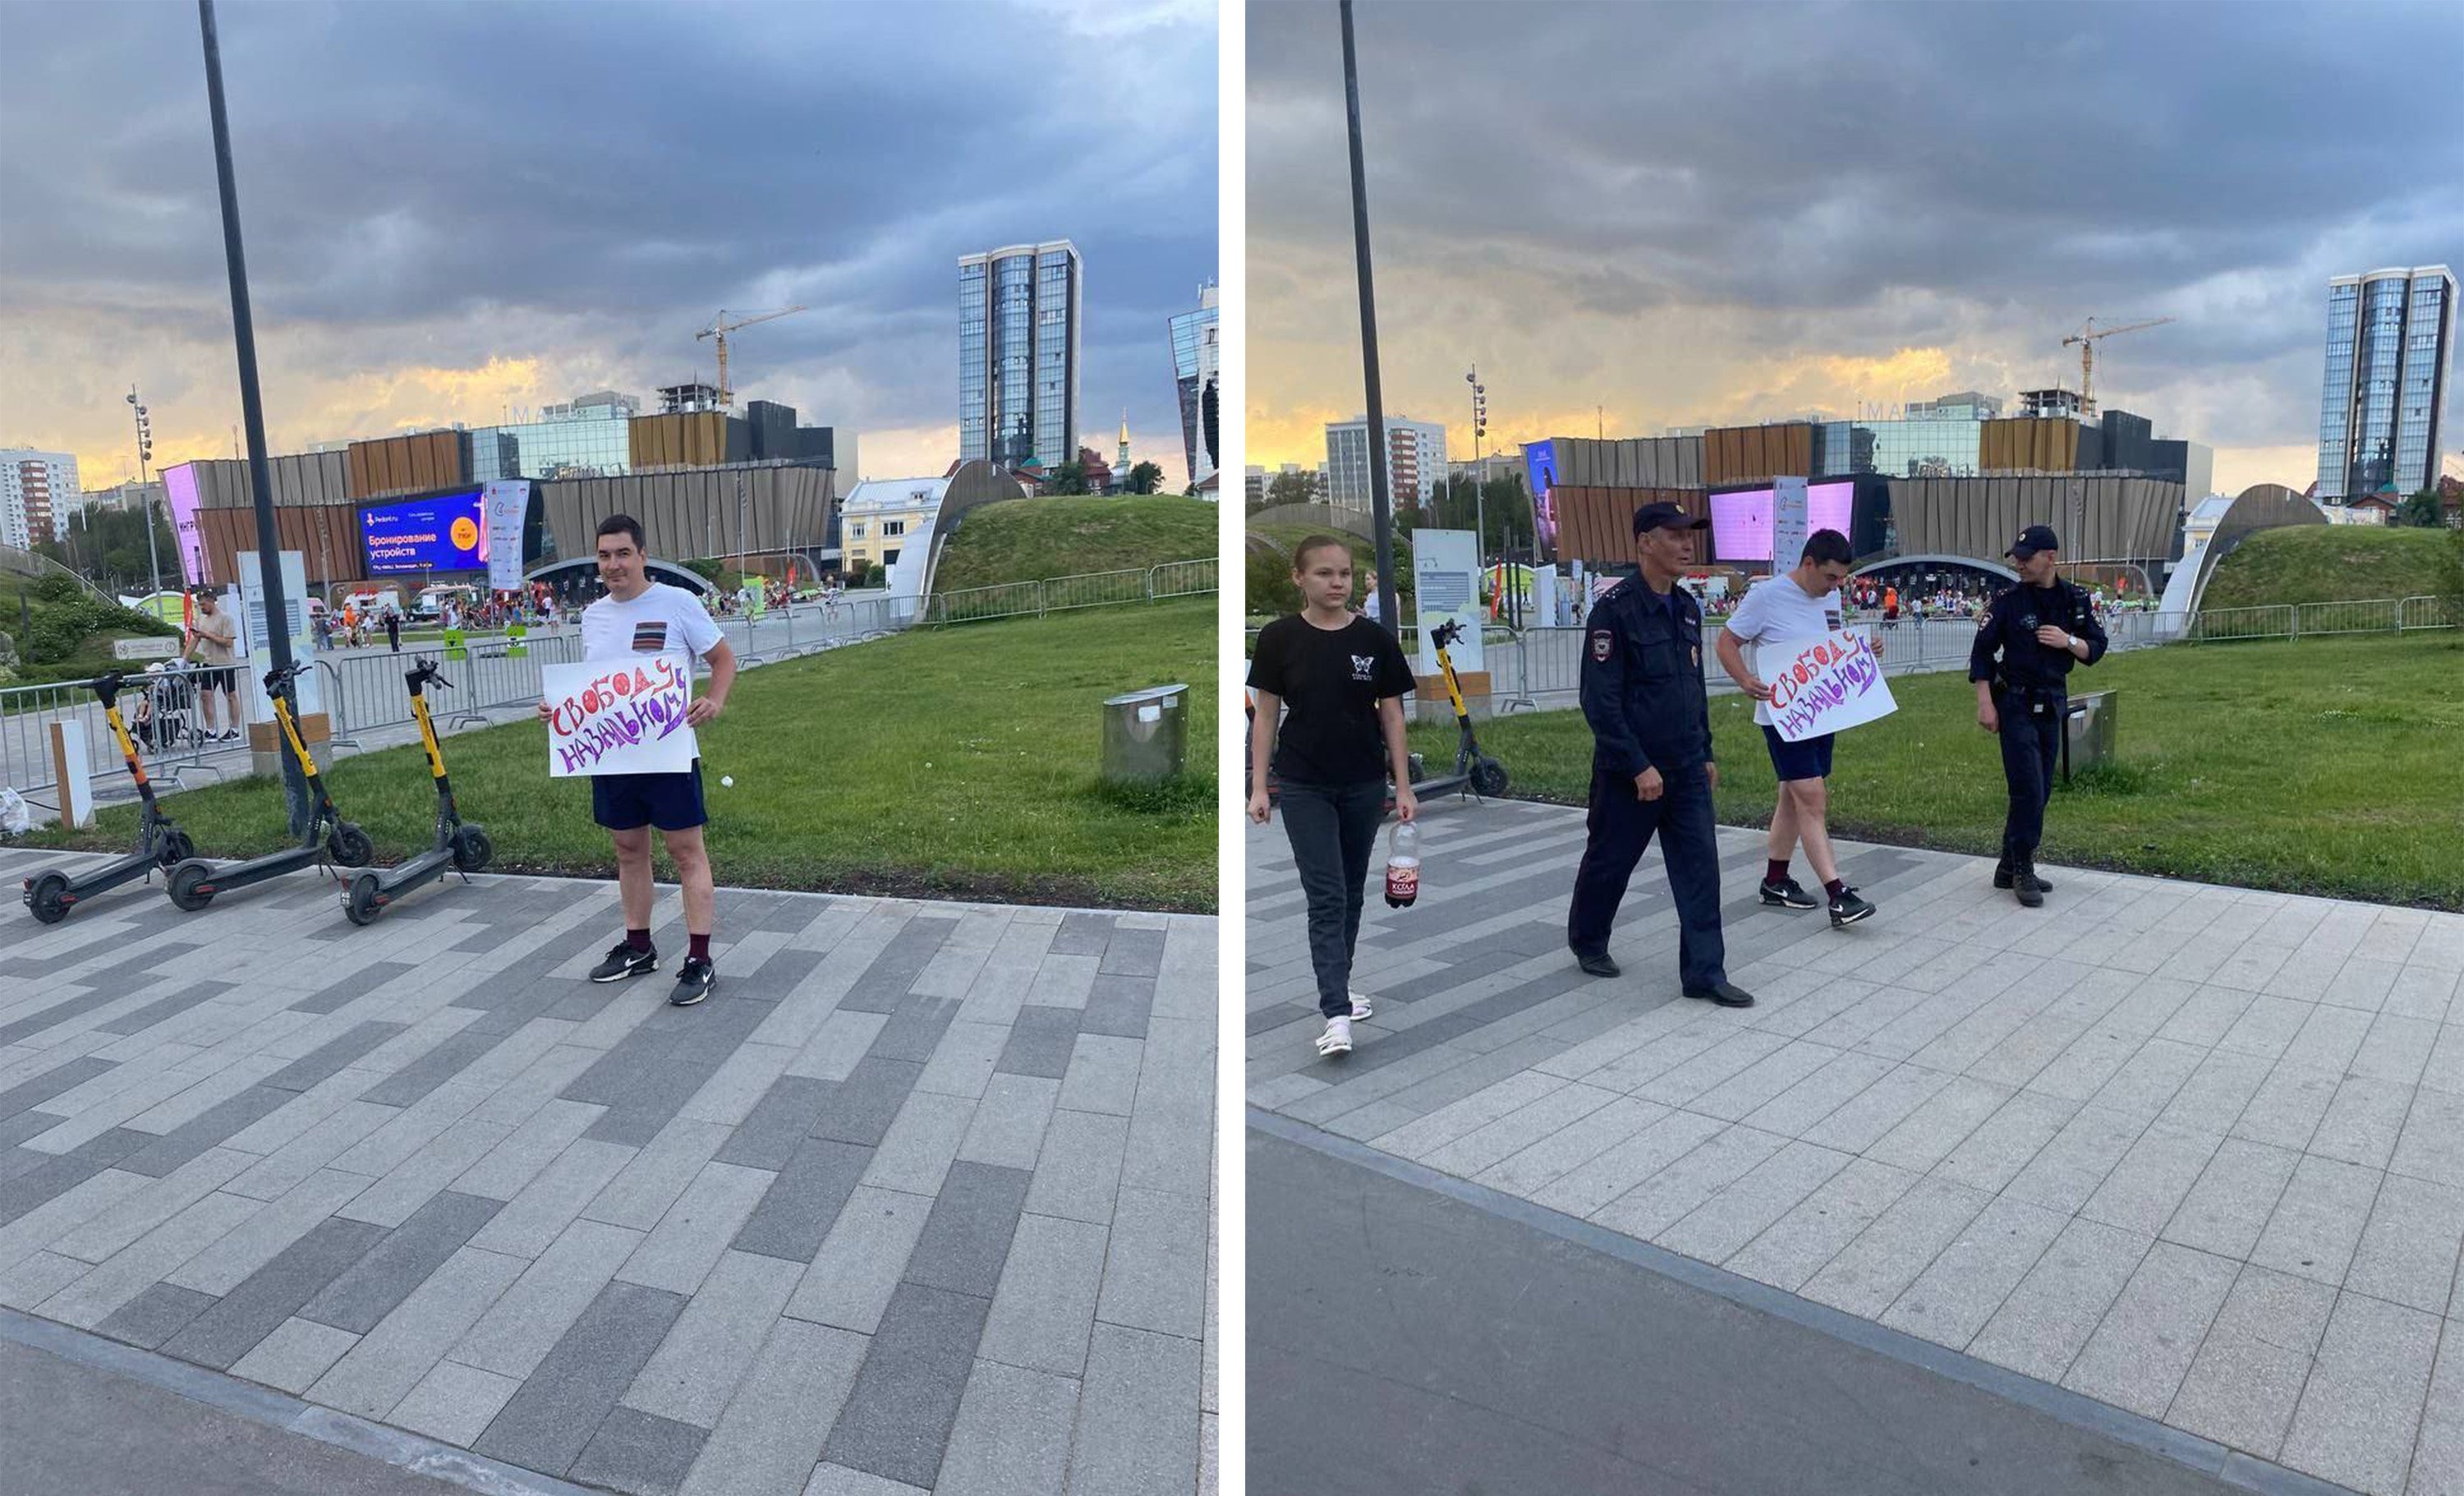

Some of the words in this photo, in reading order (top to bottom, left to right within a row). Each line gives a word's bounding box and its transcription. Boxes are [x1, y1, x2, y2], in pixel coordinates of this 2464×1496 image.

[369, 533, 436, 547] Бронирование
[370, 547, 416, 560] устройств
[553, 658, 674, 736] СВОБОДУ
[1770, 630, 1859, 709] СВОБОДУ
[1777, 635, 1877, 739] НАВАЛЬНОМУ
[558, 667, 687, 773] НАВАЛЬНОМУ
